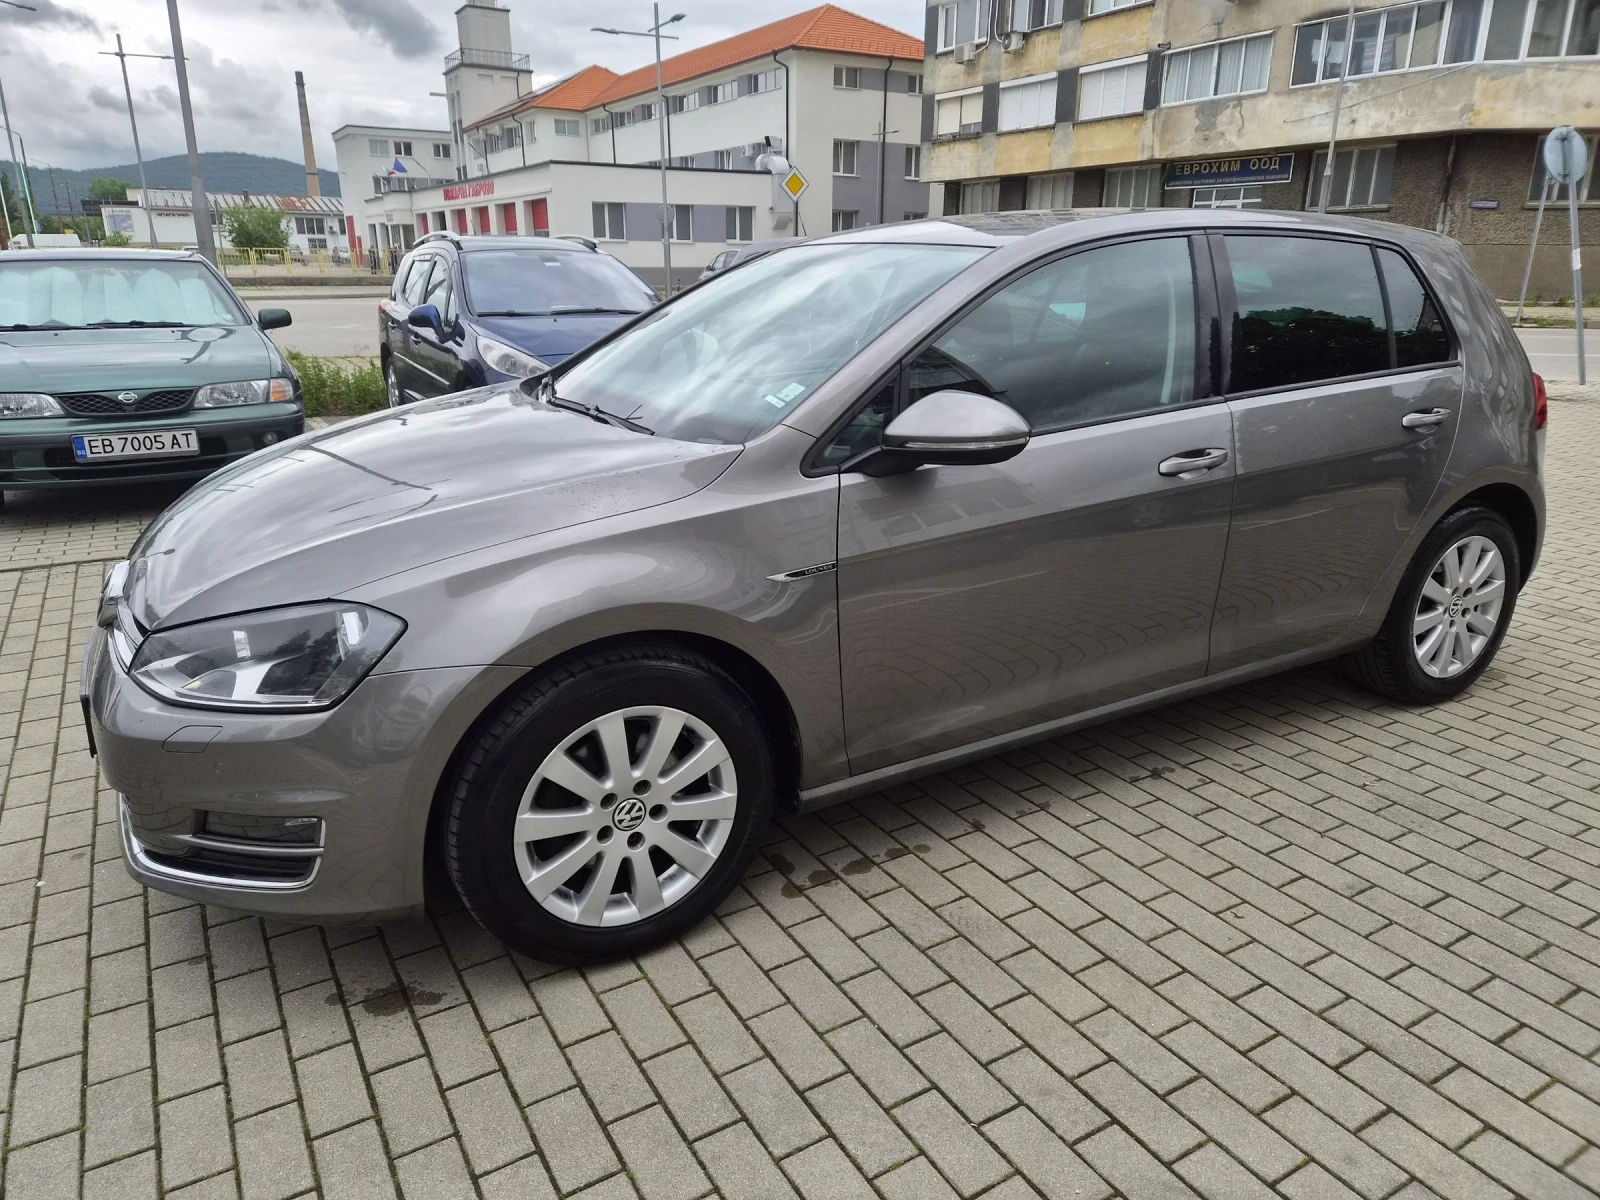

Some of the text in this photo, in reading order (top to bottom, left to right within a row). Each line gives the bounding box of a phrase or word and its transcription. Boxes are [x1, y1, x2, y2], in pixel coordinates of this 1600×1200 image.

[1175, 157, 1280, 175] ЕВРОХИМ ООД
[88, 432, 193, 455] EB 7005 AT
